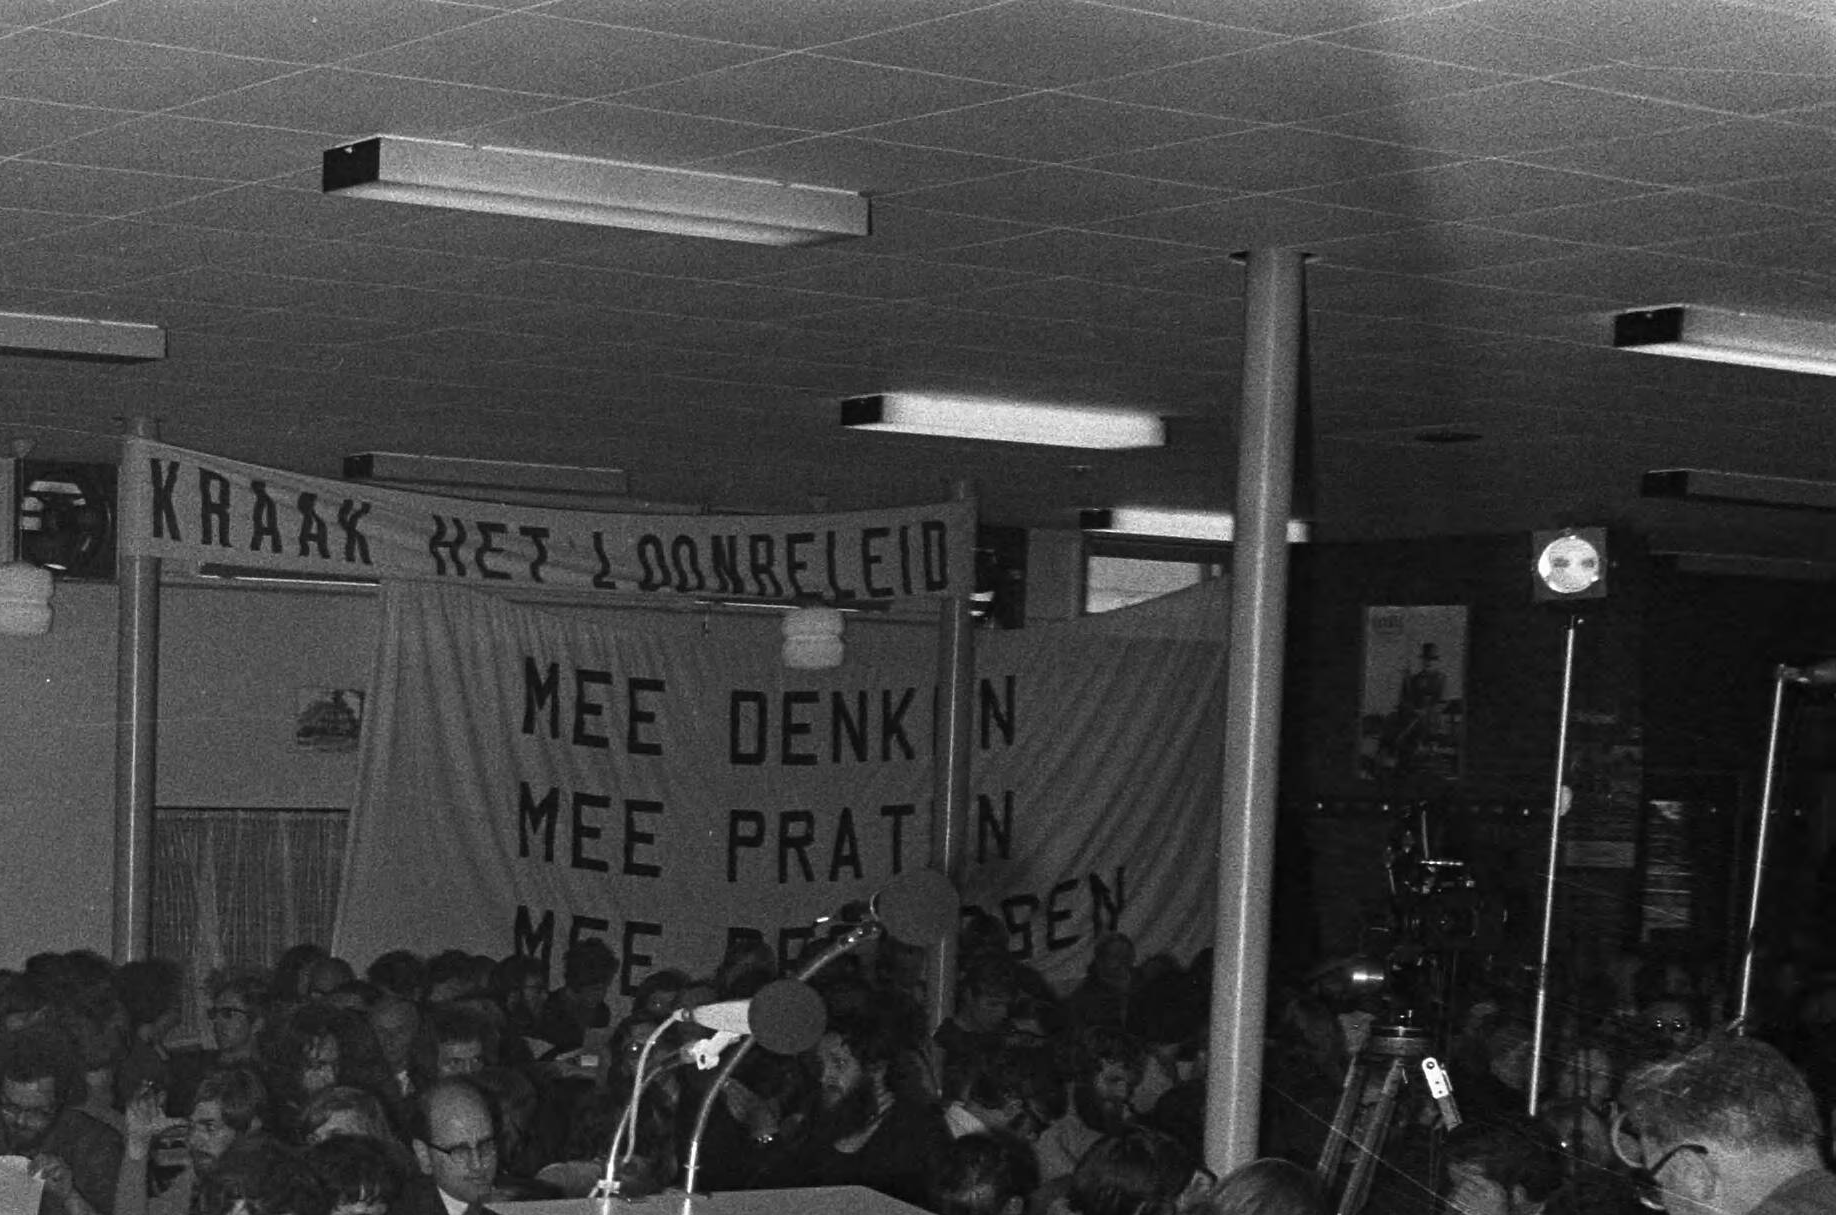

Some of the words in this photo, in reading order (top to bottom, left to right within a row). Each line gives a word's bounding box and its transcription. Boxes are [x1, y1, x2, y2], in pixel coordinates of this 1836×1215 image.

[149, 457, 373, 566] KRAAK
[428, 513, 551, 583] HET
[521, 655, 664, 756] MEE
[729, 674, 1017, 767] DENKN
[518, 781, 663, 878] MEE
[726, 790, 1015, 884] PRATN
